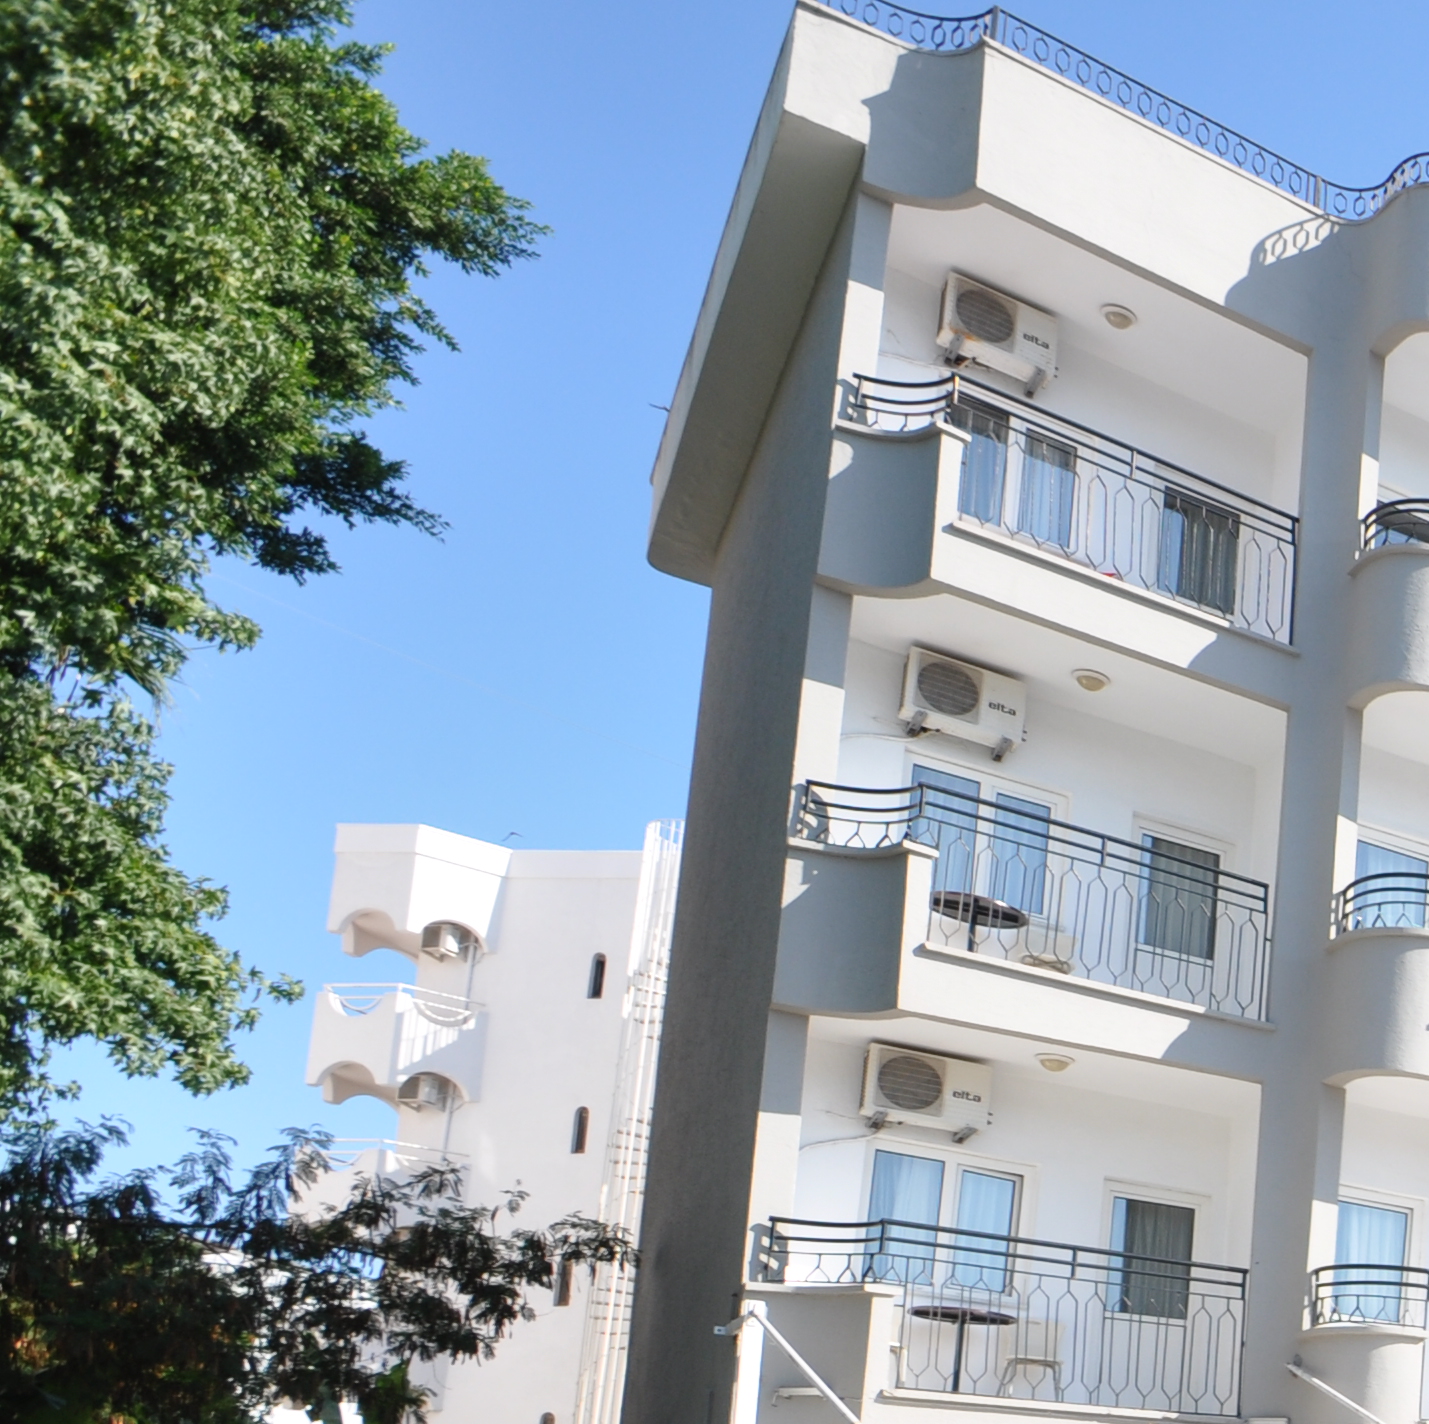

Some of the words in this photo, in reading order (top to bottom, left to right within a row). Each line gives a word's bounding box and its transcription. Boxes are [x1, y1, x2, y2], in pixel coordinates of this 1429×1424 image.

[1023, 333, 1050, 350] elta
[988, 701, 1017, 716] elta
[952, 1090, 981, 1103] elta
